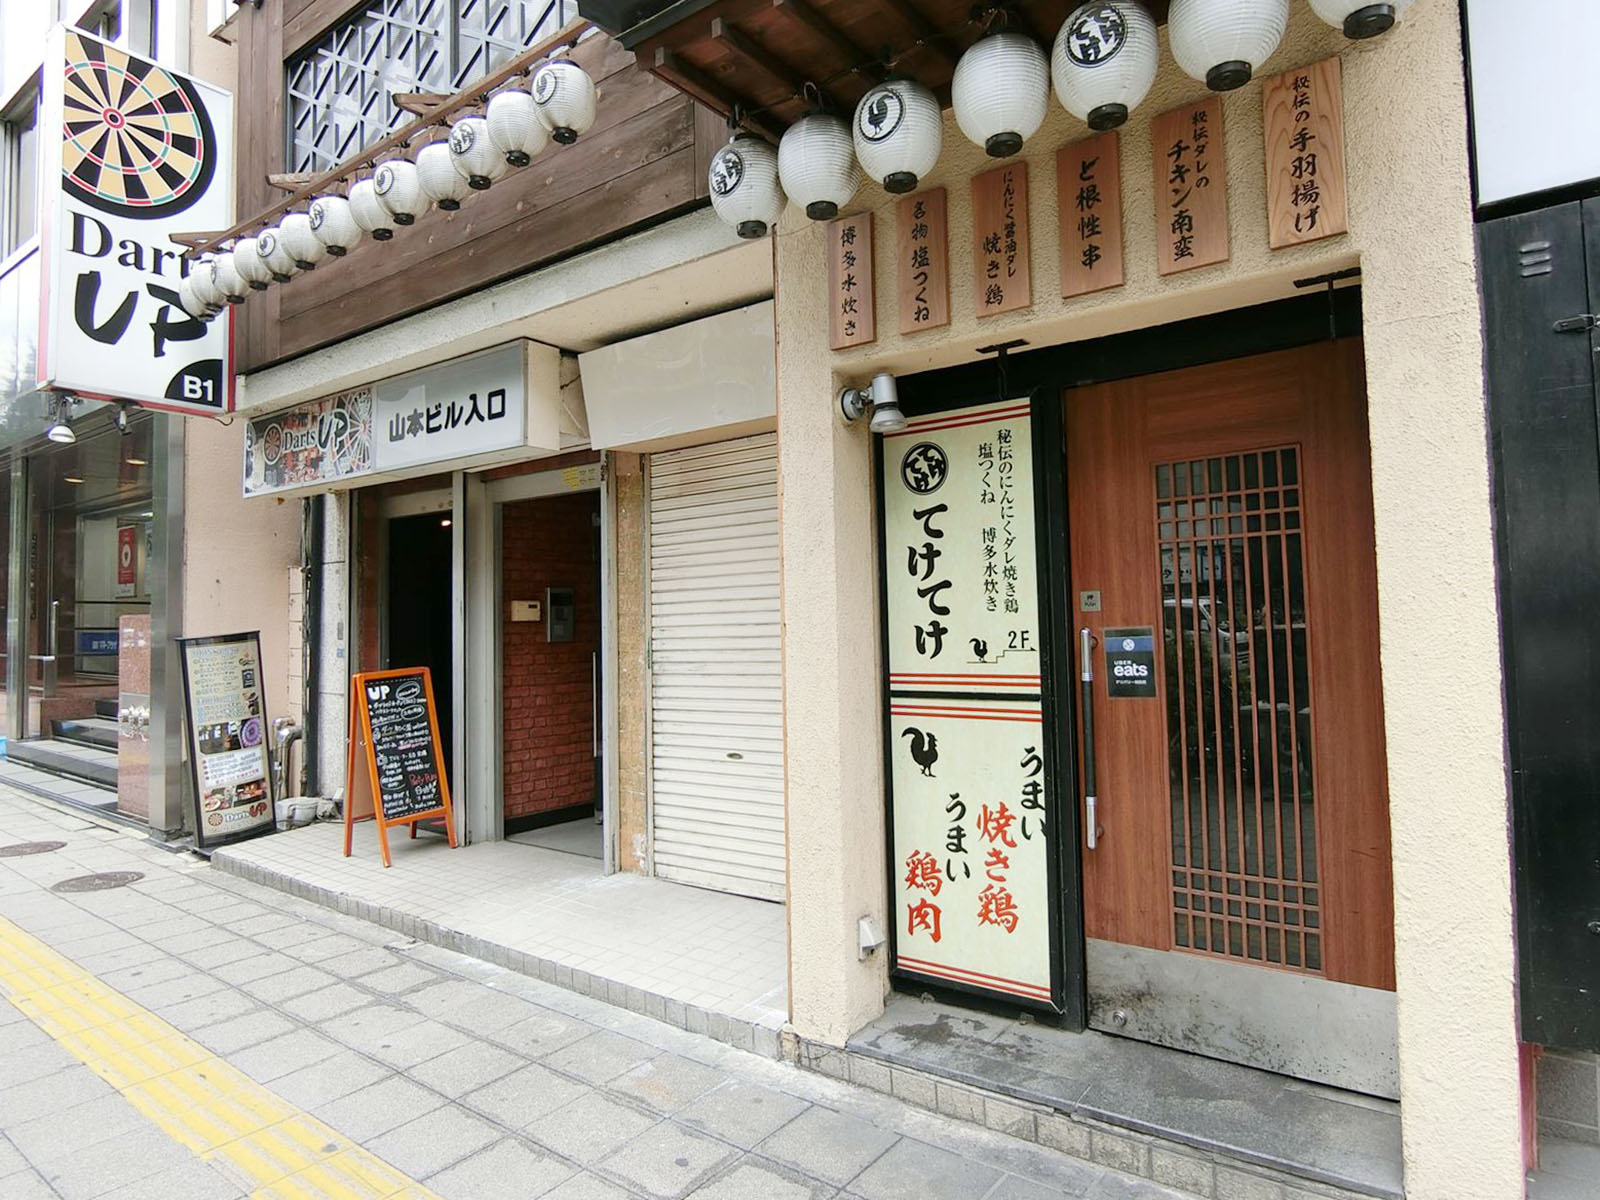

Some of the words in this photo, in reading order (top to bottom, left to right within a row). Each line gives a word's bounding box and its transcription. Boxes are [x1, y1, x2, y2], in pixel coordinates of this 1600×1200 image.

[1192, 110, 1209, 188] 秘伝ダレの
[1288, 75, 1321, 233] 秘伝の手羽揚げ
[66, 209, 192, 279] Dart
[1076, 157, 1102, 270] ど根性串
[1167, 139, 1195, 262] チキン南蛮
[840, 225, 858, 337] 博多水炊き
[912, 201, 930, 323] 名物塩つくね
[983, 232, 1003, 308] 焼き鶏
[183, 375, 214, 401] B1
[284, 429, 316, 450] Darts
[318, 410, 349, 449] UP
[389, 388, 506, 442] 山本ビル入口
[978, 442, 996, 505] 塩つくね
[997, 428, 1019, 614] 秘伝のにんにくダレ焼き鶏
[907, 503, 953, 660] てけてけ
[982, 527, 998, 612] 博多水炊き
[1008, 630, 1030, 649] 2F
[1113, 663, 1149, 677] eats
[367, 685, 390, 700] UP
[1020, 746, 1047, 840] うまい
[945, 792, 971, 882] うまい
[976, 801, 1019, 934] 焼き鶏
[905, 849, 943, 943] 鶏肉
